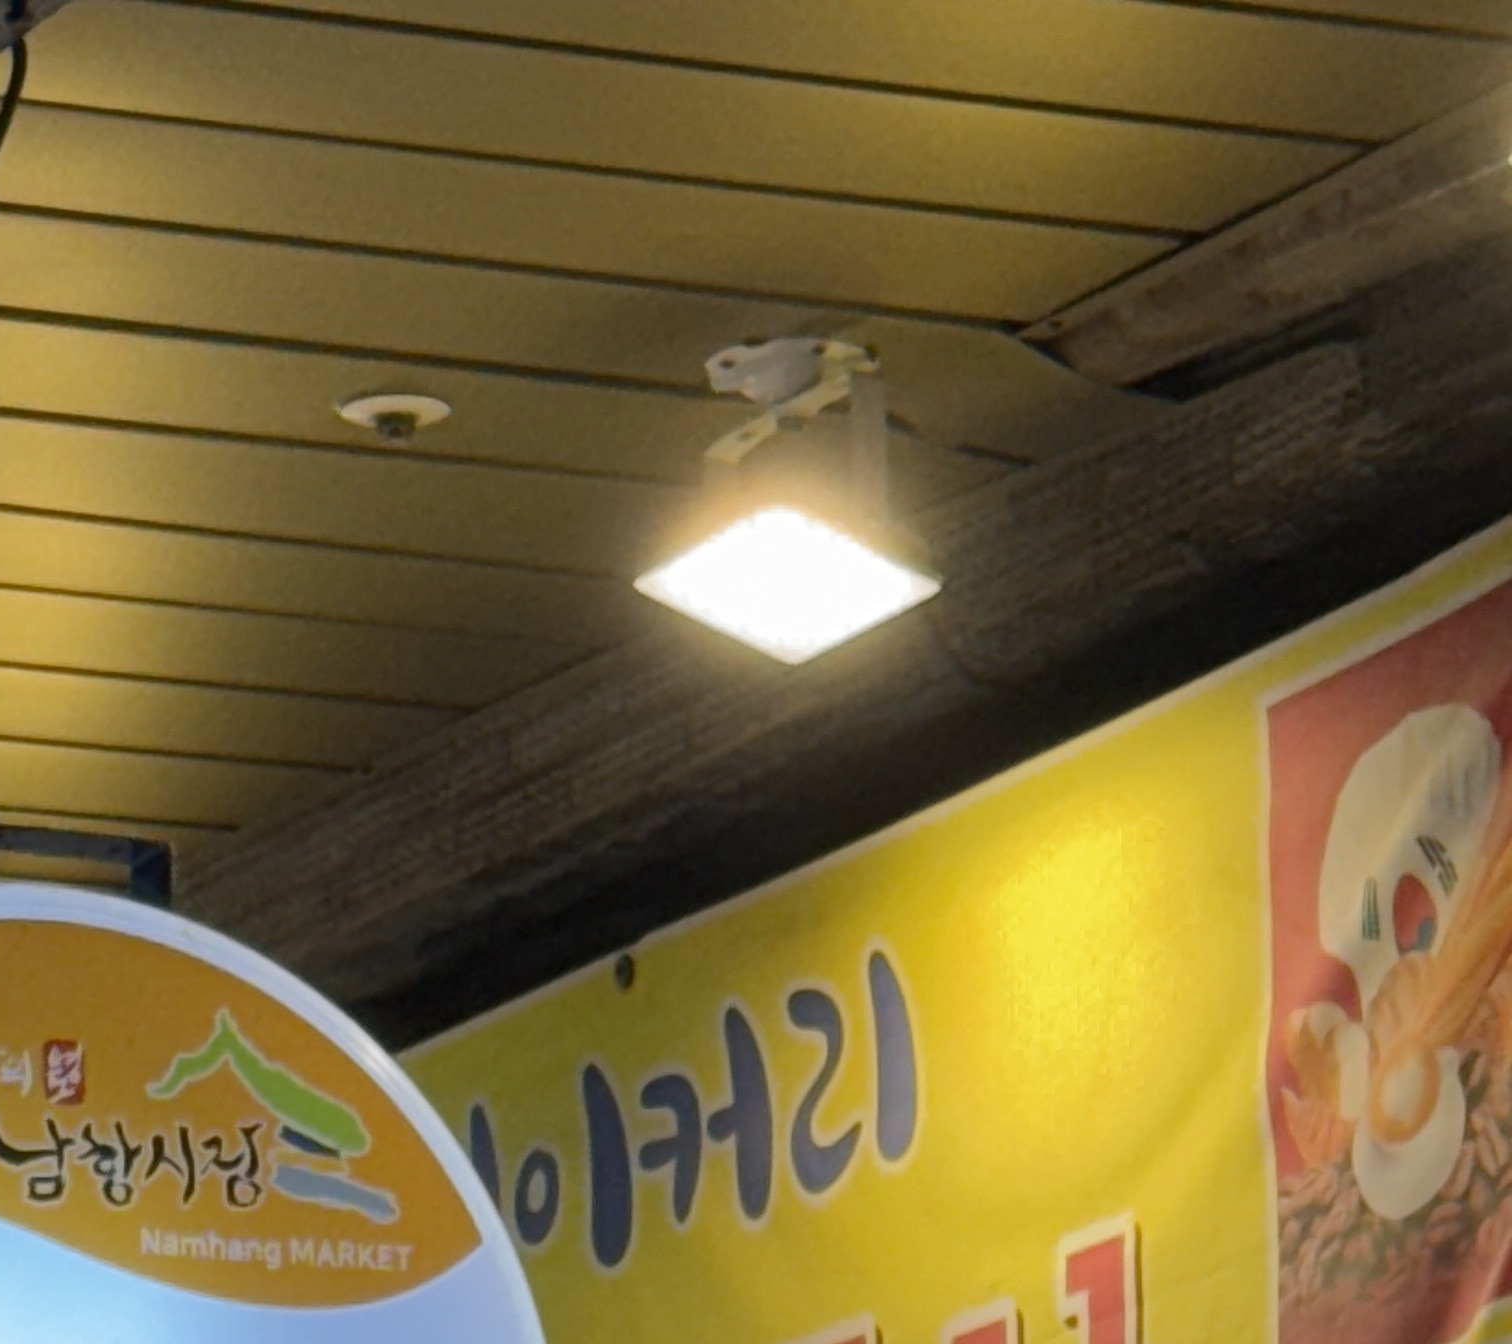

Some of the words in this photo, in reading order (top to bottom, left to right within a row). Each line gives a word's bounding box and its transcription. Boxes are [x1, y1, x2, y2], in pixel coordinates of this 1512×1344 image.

[470, 949, 918, 1267] 이커리
[140, 1228, 283, 1268] Namhang
[290, 1239, 414, 1272] MARKET
